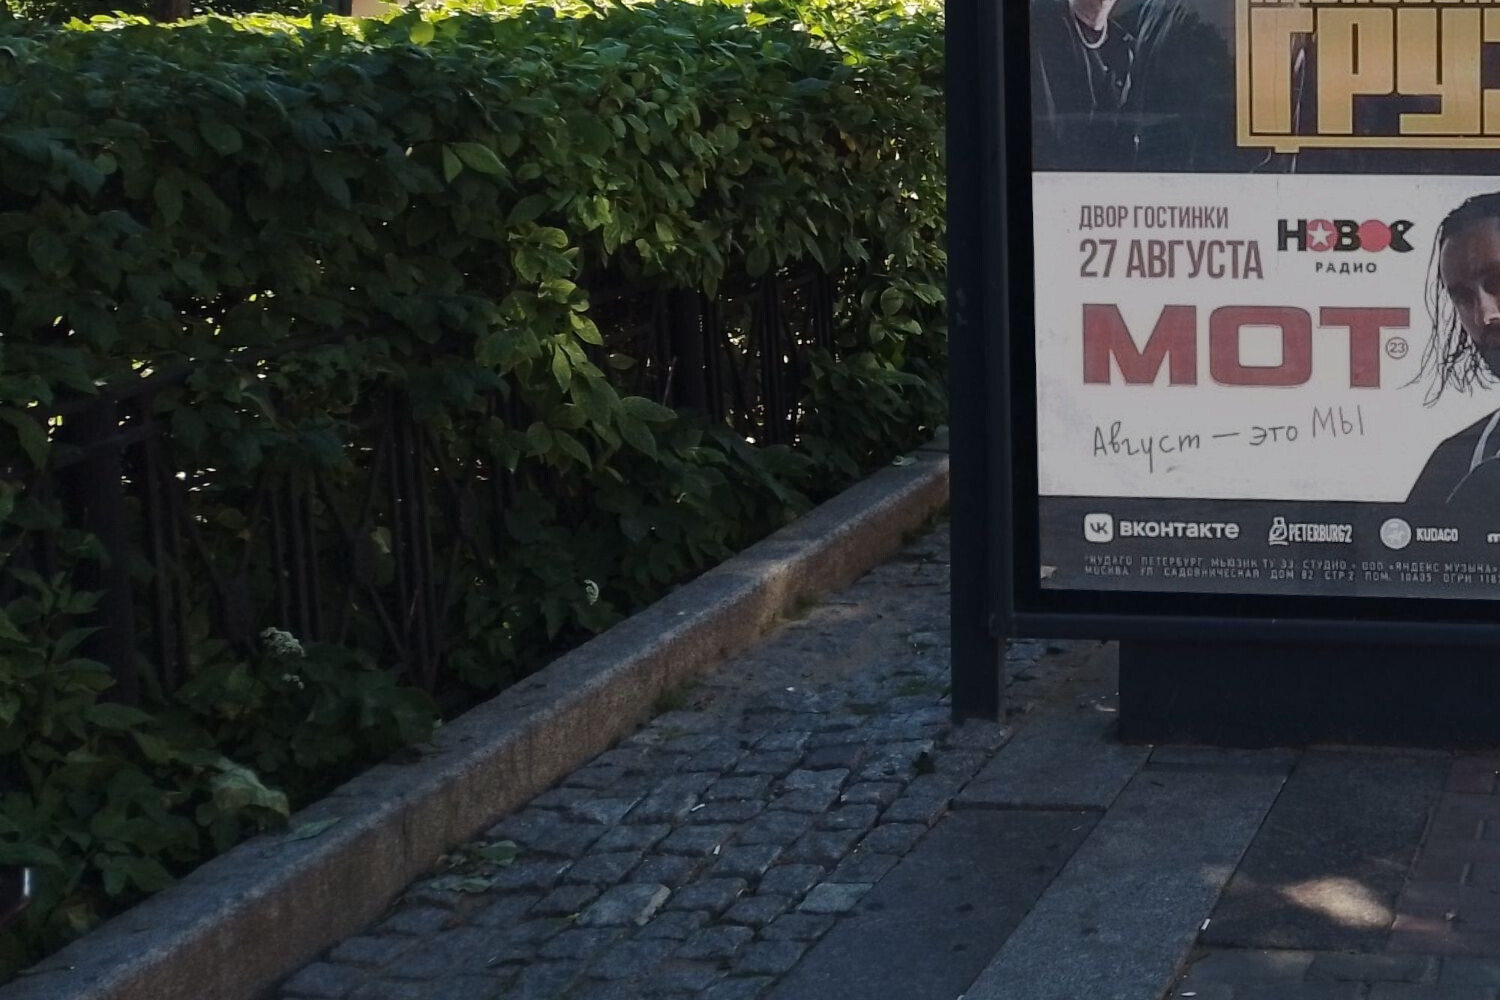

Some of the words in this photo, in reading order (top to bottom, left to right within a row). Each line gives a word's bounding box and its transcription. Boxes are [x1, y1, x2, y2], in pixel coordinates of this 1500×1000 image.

[1079, 204, 1129, 230] ДВОР
[1133, 205, 1229, 229] ГОСТИНКИ
[1079, 238, 1118, 278] 27
[1125, 239, 1264, 279] АВГУСТА
[1315, 261, 1378, 274] РАДИО
[1083, 303, 1411, 388] МОТ
[1093, 421, 1201, 473] Август
[1249, 425, 1298, 446] это
[1312, 405, 1364, 438] МЫ
